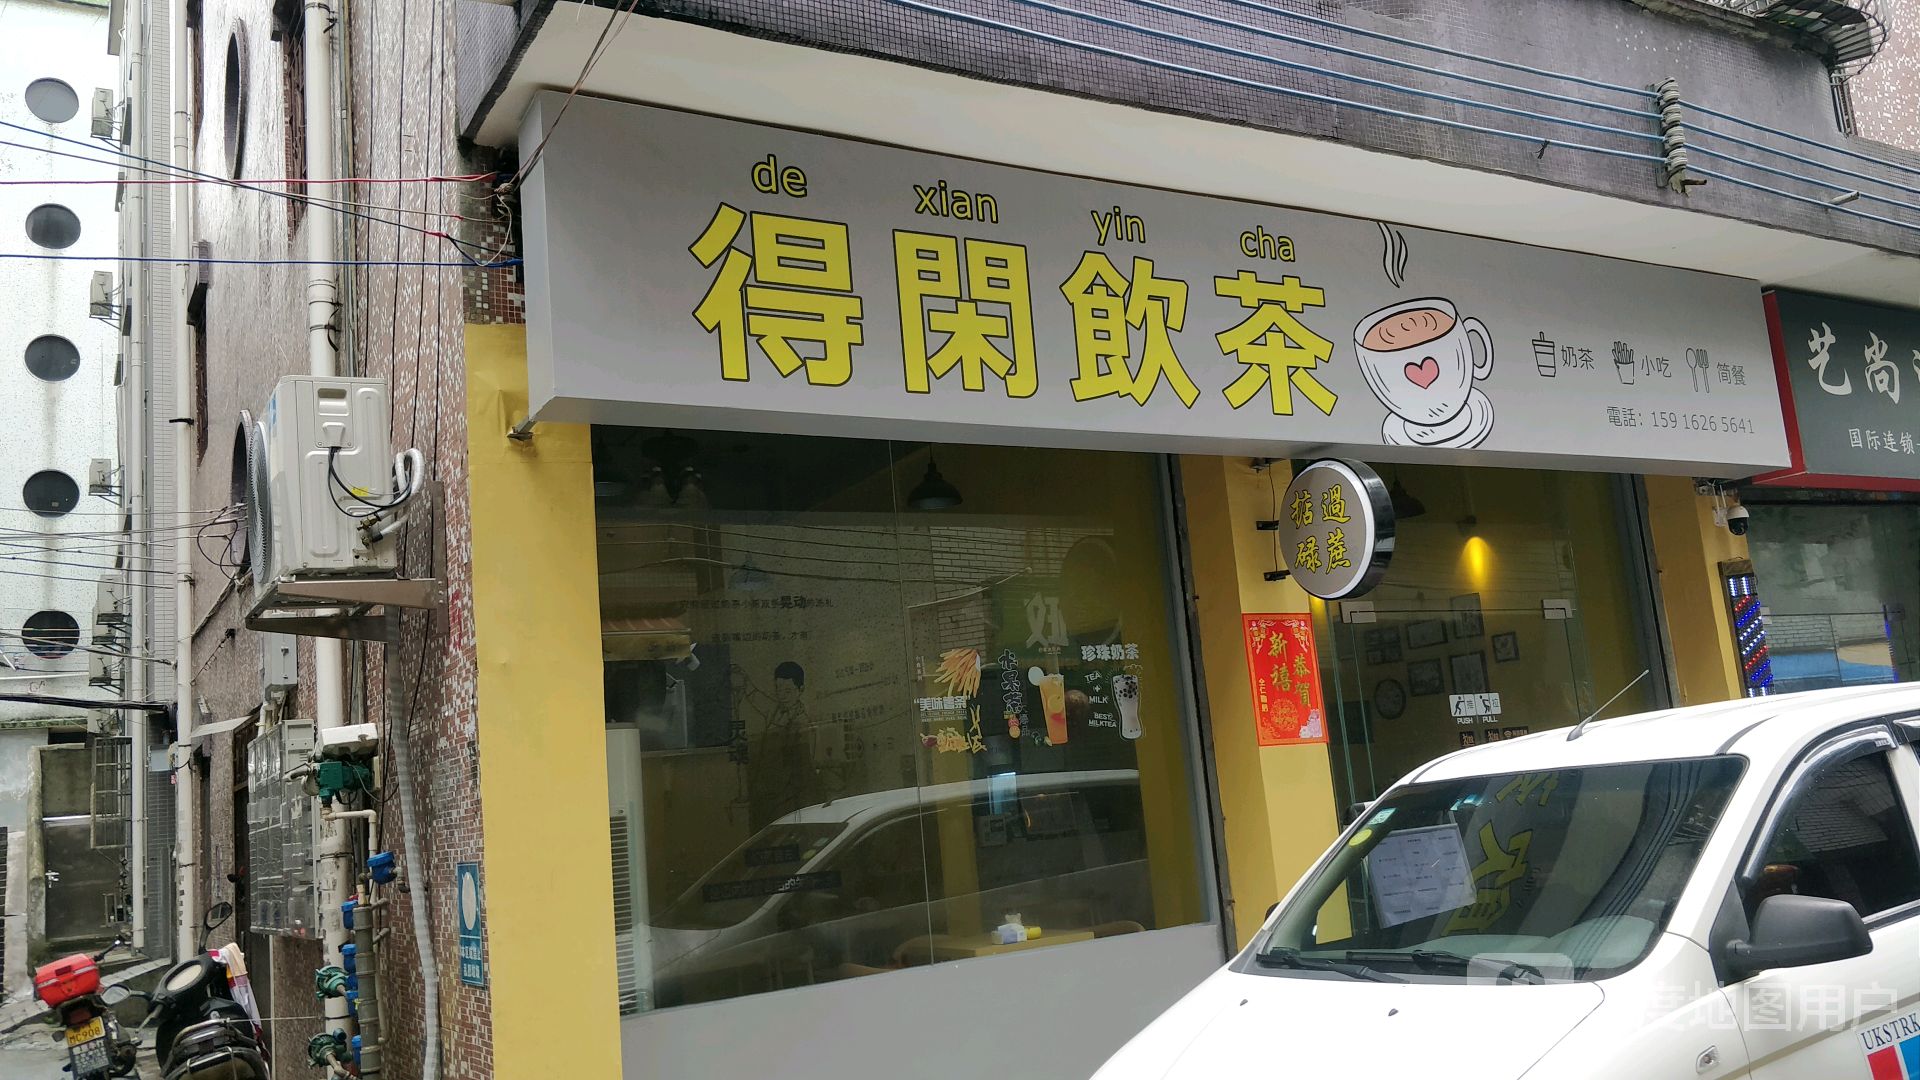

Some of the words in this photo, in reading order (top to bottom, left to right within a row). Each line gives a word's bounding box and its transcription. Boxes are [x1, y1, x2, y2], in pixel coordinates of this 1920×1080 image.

[751, 154, 809, 198] de
[914, 180, 999, 225] xian
[1091, 205, 1146, 246] yin
[1240, 225, 1296, 263] cha
[688, 202, 1339, 417] 得閑飲茶
[1561, 345, 1596, 370] 奶茶
[1640, 354, 1672, 379] 小吃
[1716, 361, 1747, 386] 简餐
[1807, 321, 1920, 405] 艺尚
[1651, 411, 1678, 430] 159
[1682, 413, 1717, 432] 1626
[1721, 416, 1755, 434] 5641
[1848, 427, 1920, 455] 国际连锁
[1081, 642, 1140, 662] 珍珠奶茶
[1084, 671, 1102, 683] TEA
[1088, 695, 1108, 705] MILK
[1088, 719, 1117, 728] MILKTEA
[1094, 712, 1112, 721] BEST
